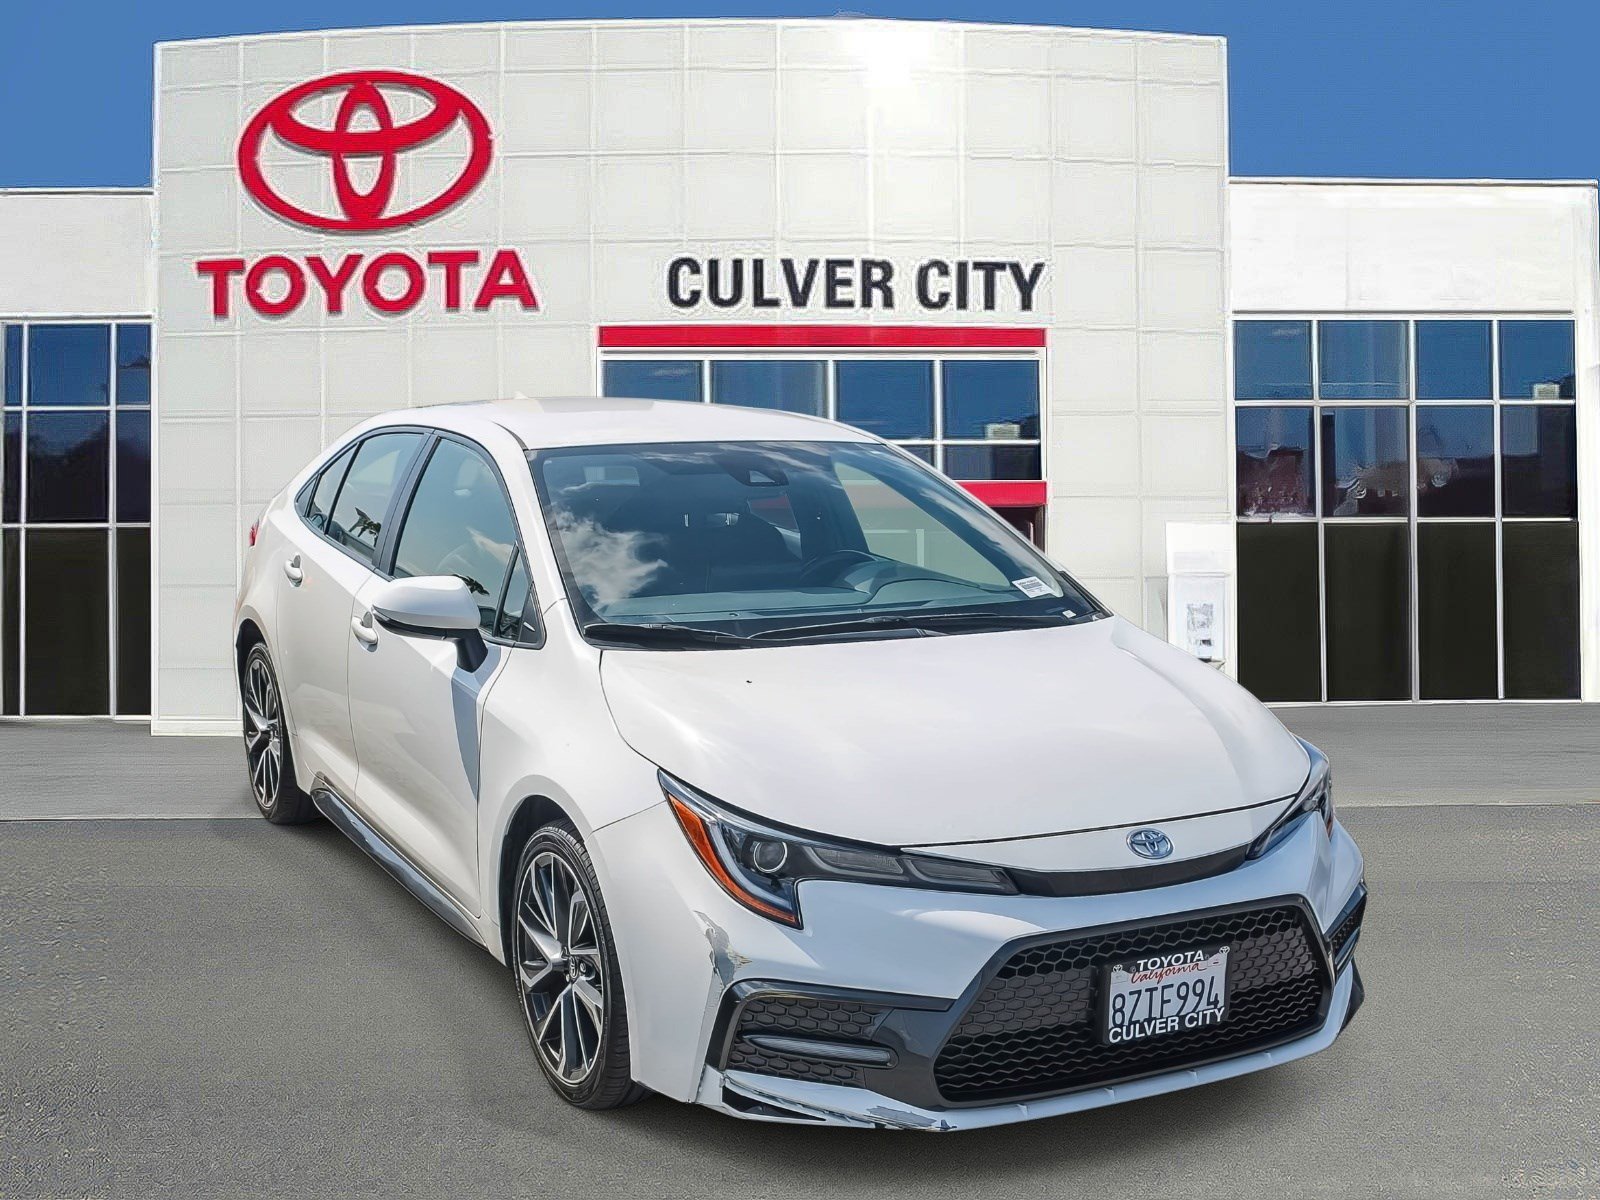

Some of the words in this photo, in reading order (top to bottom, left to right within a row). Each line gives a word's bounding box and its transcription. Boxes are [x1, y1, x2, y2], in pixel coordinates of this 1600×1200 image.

[195, 249, 540, 319] TOYOTA
[667, 258, 895, 310] CULVER
[915, 259, 1045, 311] CITY
[1131, 962, 1207, 984] California
[1137, 950, 1205, 971] TOYOTA
[1112, 975, 1220, 1027] 8ZTF994
[1109, 1016, 1179, 1043] CULVER
[1184, 1007, 1225, 1028] CITY
